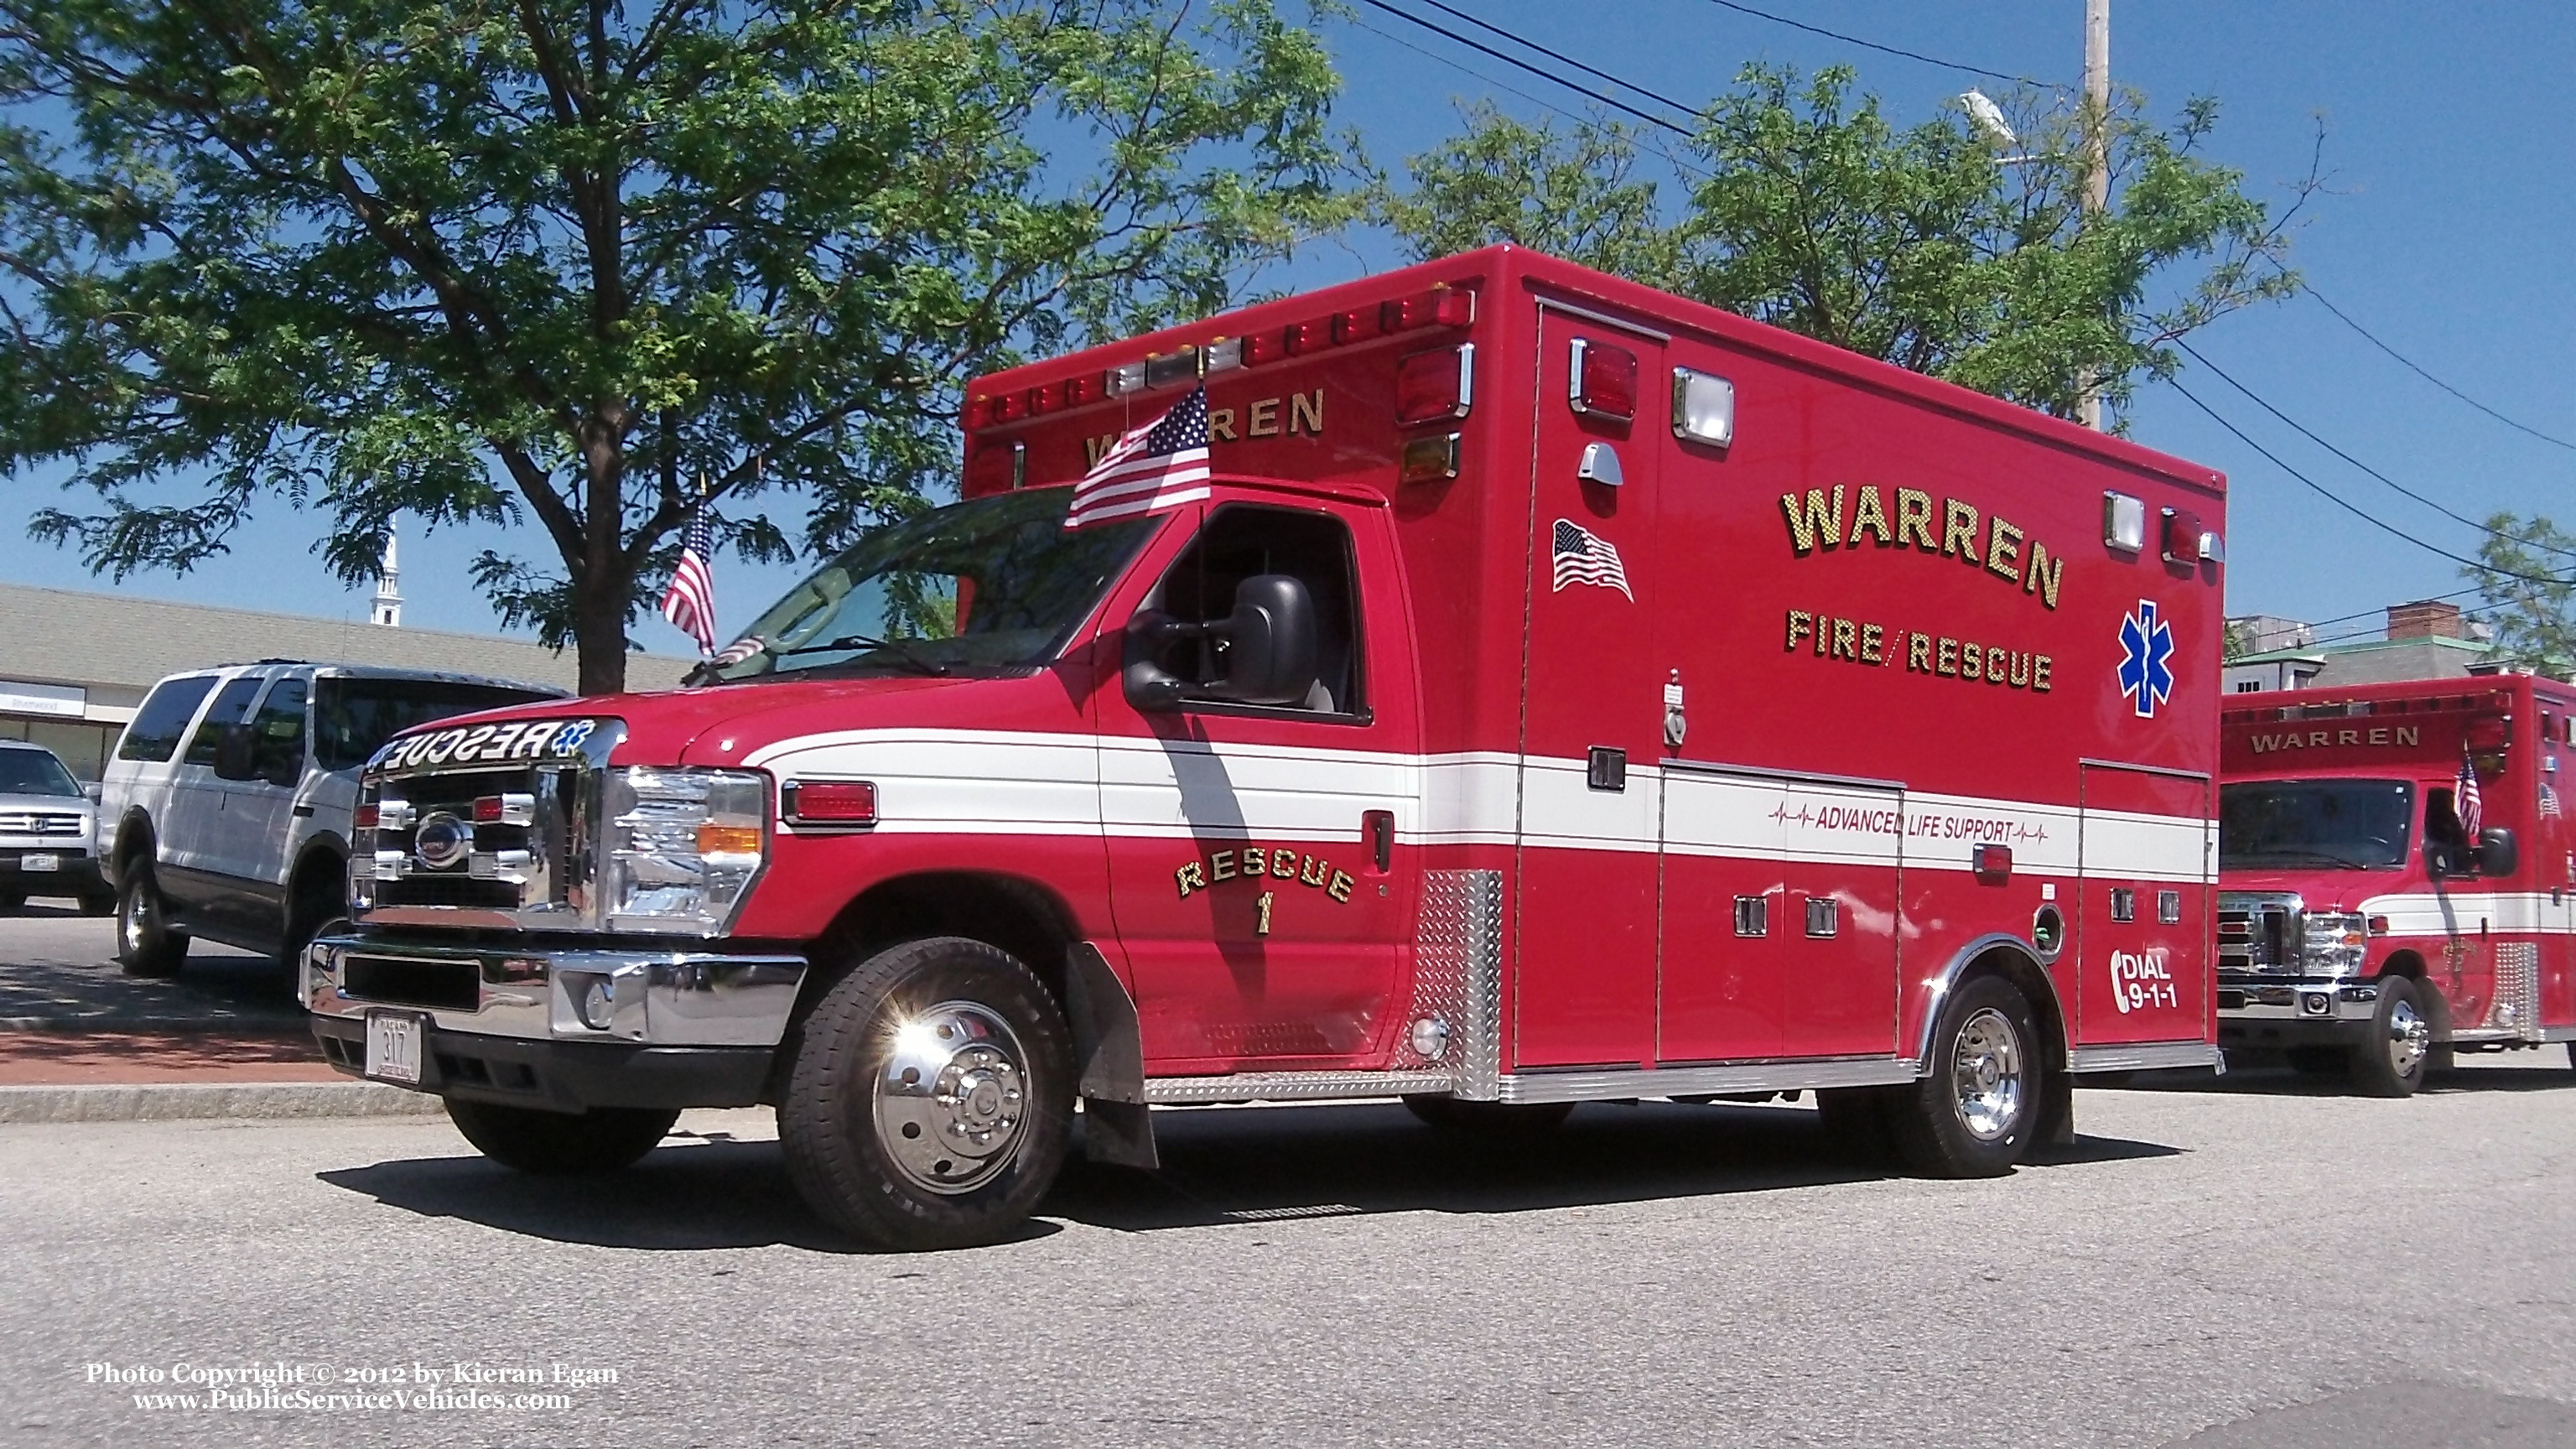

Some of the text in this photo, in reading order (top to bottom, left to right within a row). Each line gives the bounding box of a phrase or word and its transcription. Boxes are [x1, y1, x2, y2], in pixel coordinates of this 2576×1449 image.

[1086, 388, 1324, 469] WREN
[1781, 483, 2064, 610] WARREN
[1786, 609, 2052, 692] FIRE/RESCUE
[2251, 726, 2418, 753] WARREN
[1815, 806, 2013, 841] ADVANCED LIFE SUPPORT
[1176, 848, 1355, 903] RESCUE
[1258, 891, 1274, 934] 1
[2121, 954, 2171, 979] DIAL
[2128, 983, 2178, 1009] 9-1-1
[383, 1030, 406, 1064] 317
